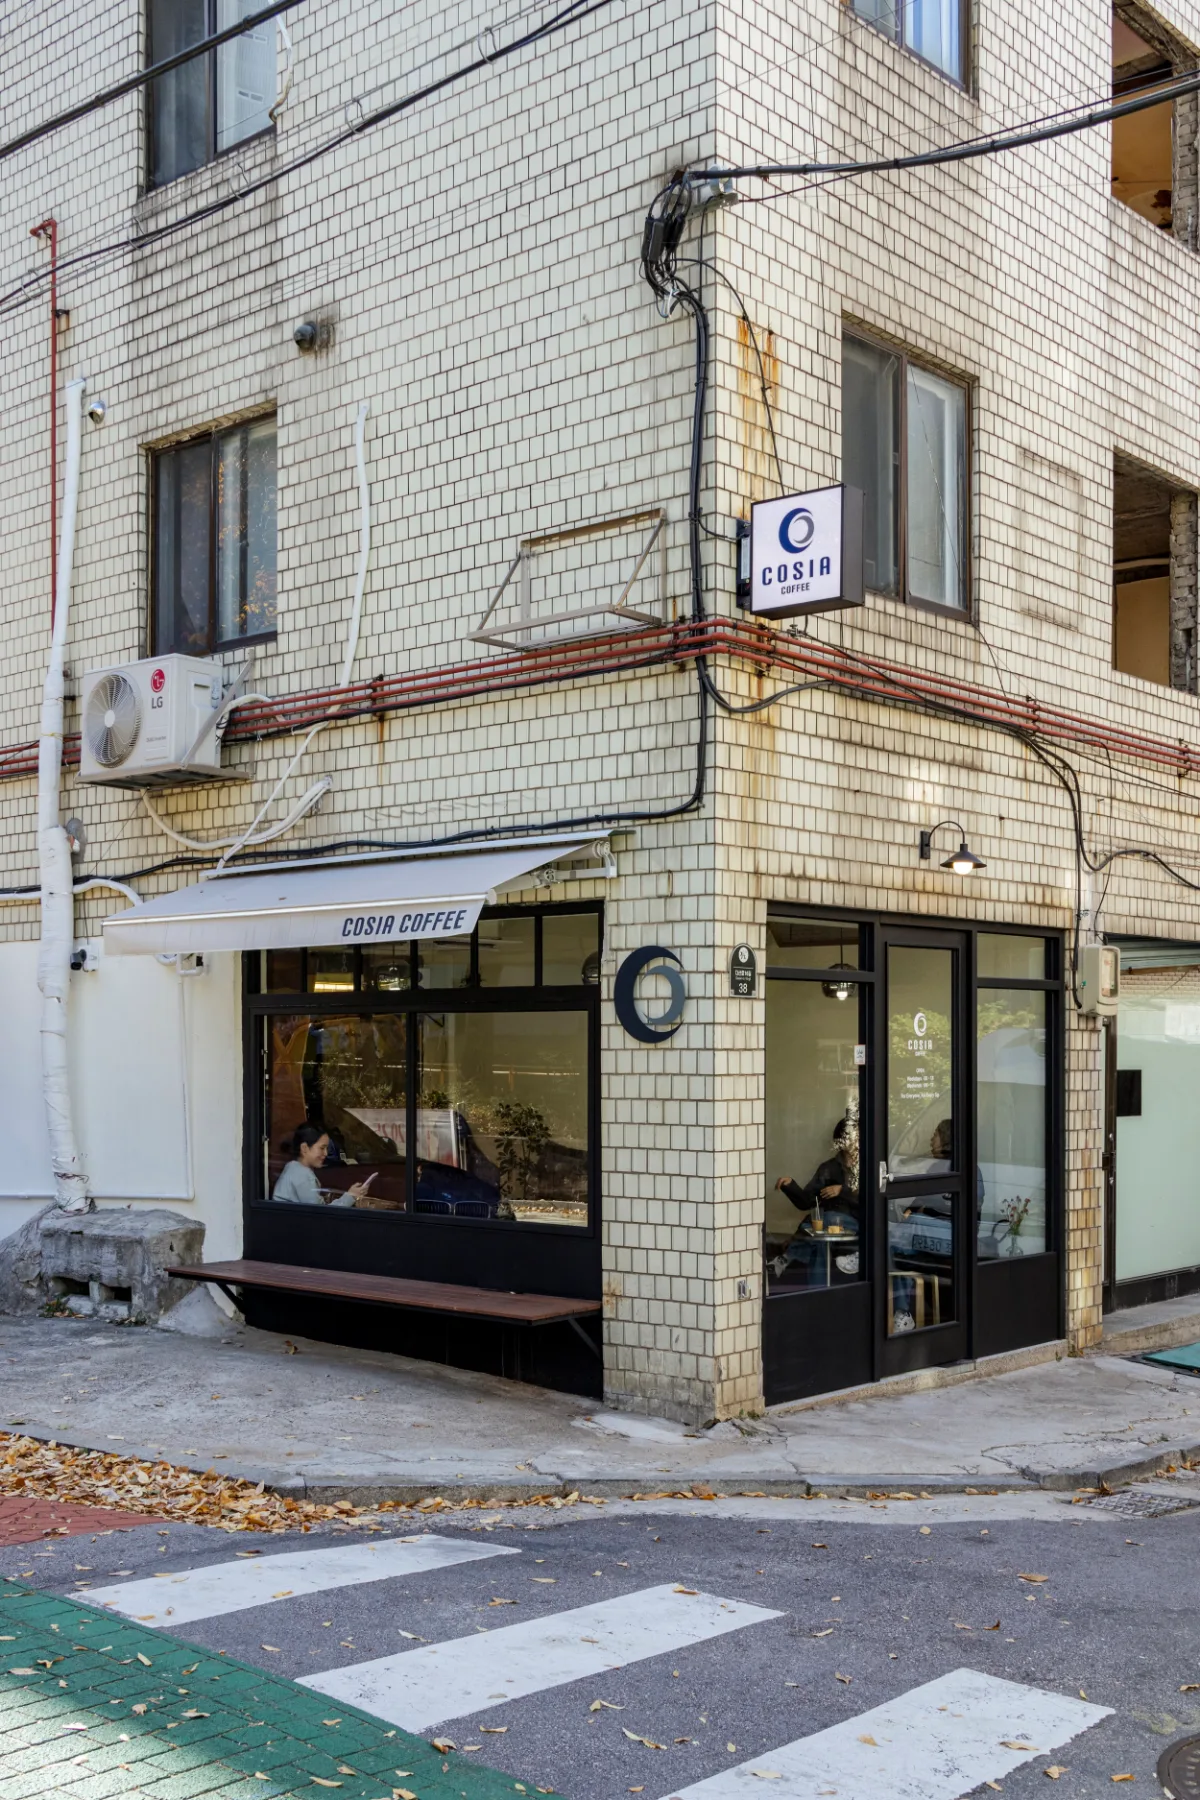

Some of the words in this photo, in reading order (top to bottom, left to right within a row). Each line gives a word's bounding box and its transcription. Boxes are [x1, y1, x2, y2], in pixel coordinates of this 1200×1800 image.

[762, 556, 831, 586] COSIA
[781, 582, 810, 595] COFFEE
[151, 696, 163, 709] LG
[342, 915, 395, 937] COSIA
[399, 909, 467, 933] COFFEE
[738, 982, 748, 994] 38
[907, 1039, 933, 1050] COSIA
